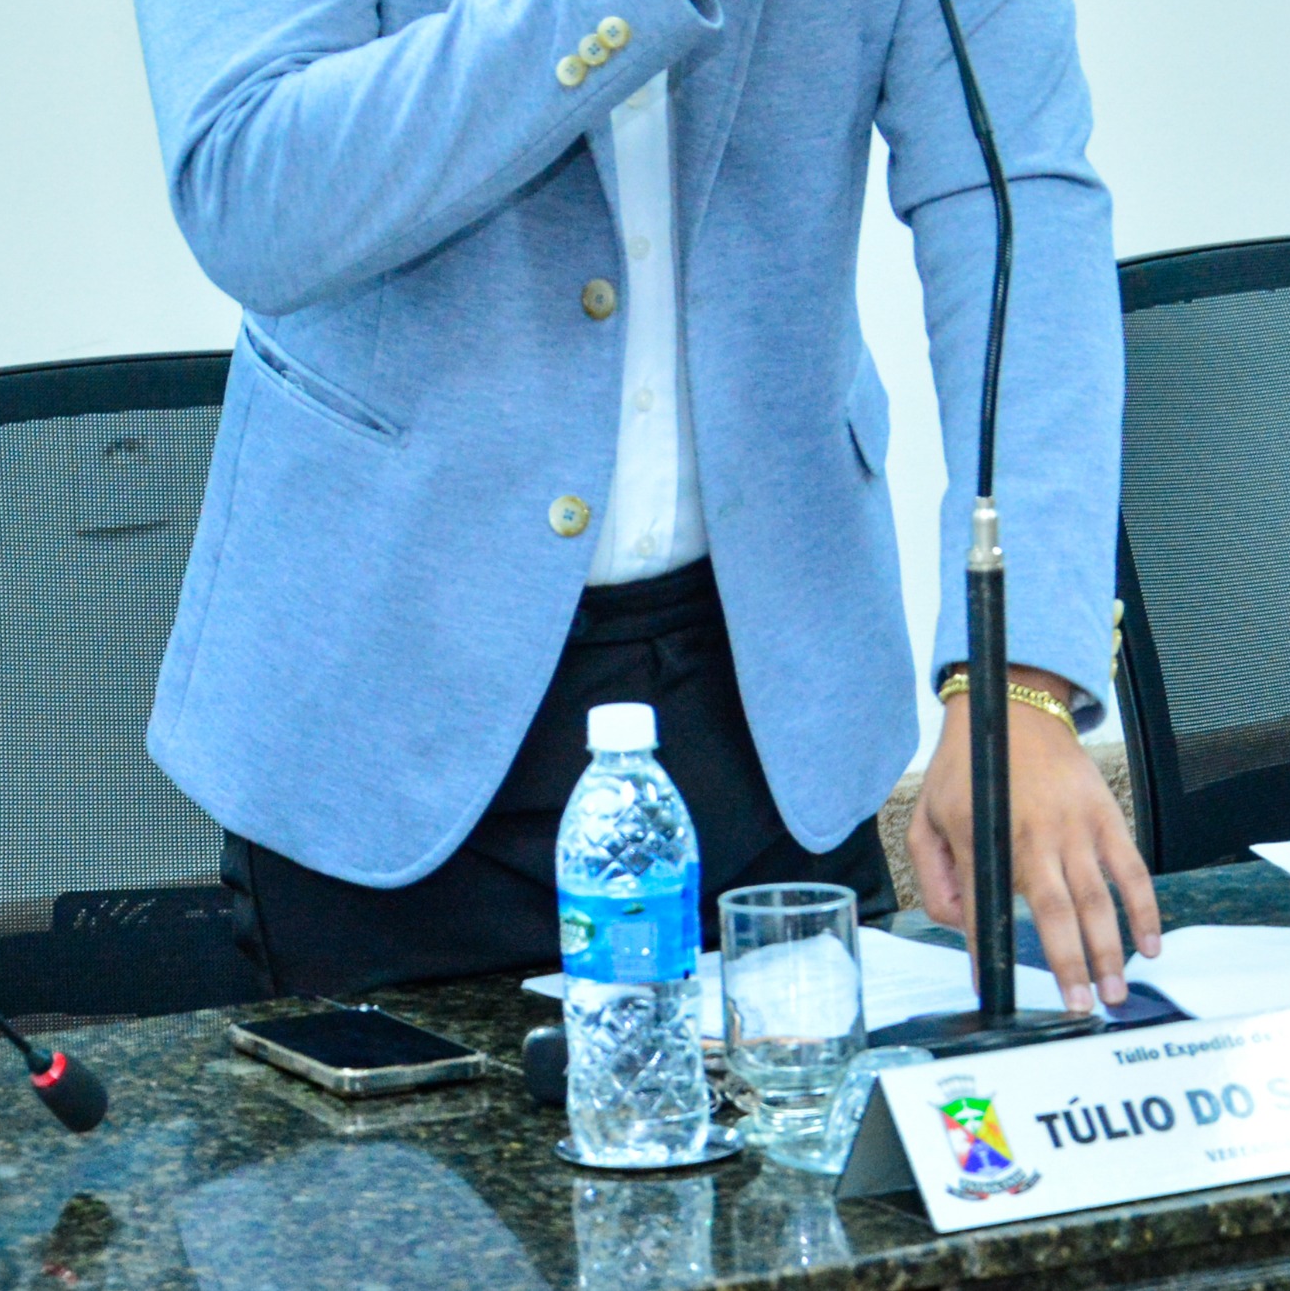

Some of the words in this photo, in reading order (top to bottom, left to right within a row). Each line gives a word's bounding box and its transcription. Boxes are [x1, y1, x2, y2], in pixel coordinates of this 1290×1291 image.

[1111, 1047, 1160, 1065] Túlio
[1161, 1034, 1246, 1059] Expedito
[1035, 1096, 1176, 1149] TÚLIO
[1184, 1082, 1255, 1126] DO
